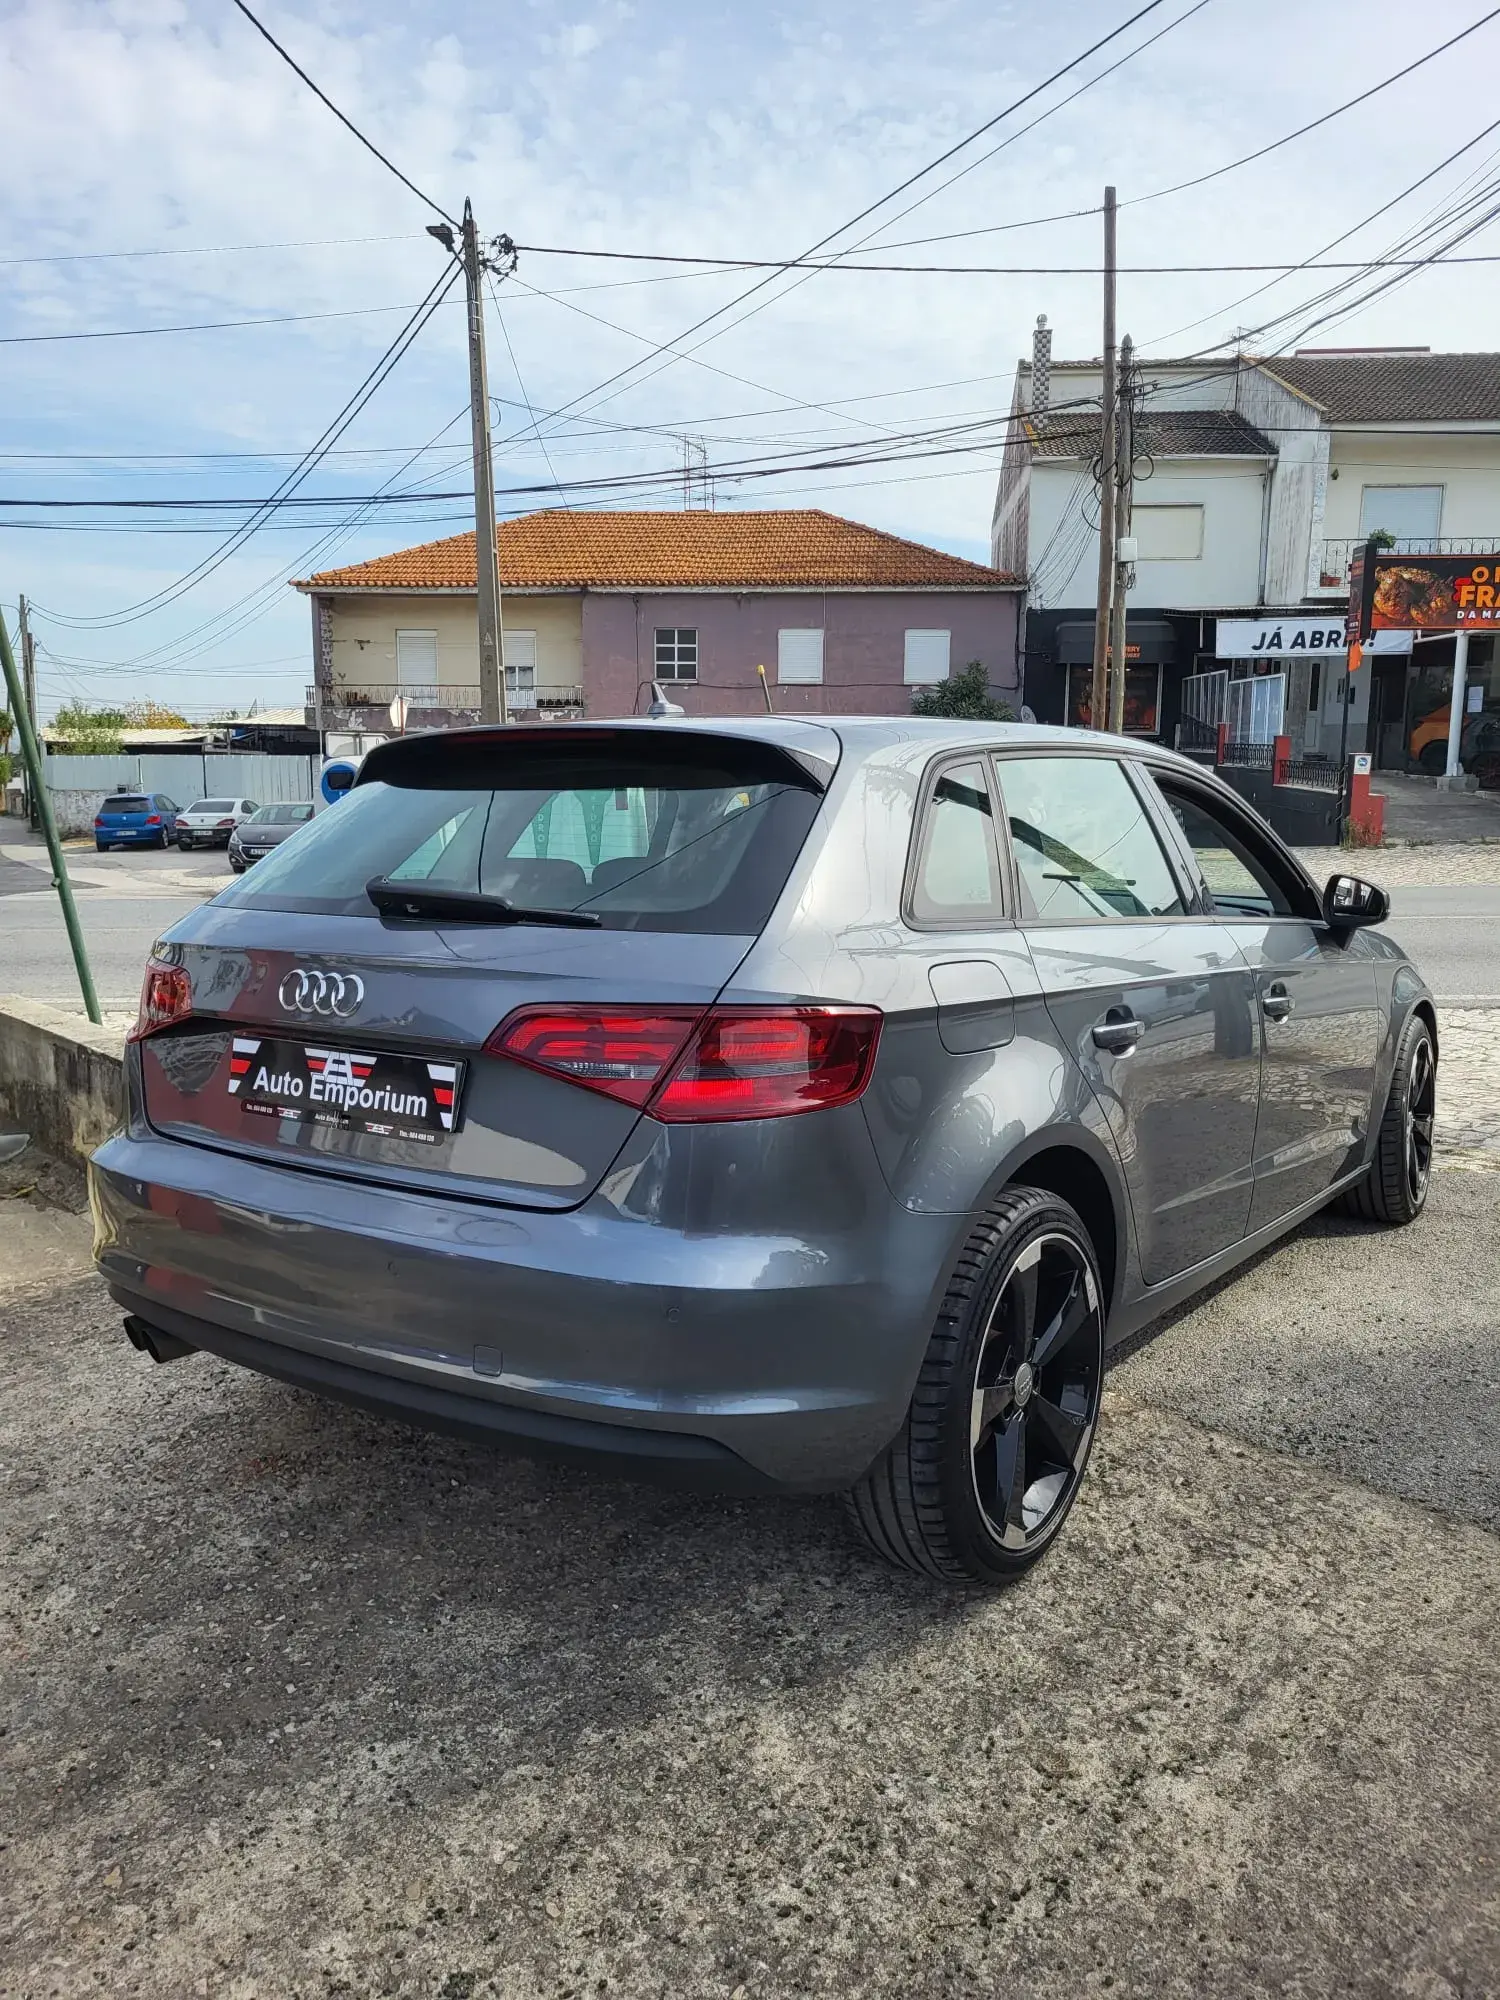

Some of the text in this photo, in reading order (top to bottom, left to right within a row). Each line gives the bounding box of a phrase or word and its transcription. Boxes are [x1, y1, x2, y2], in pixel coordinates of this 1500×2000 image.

[1251, 626, 1283, 650] JÁ
[252, 1066, 428, 1117] Auto Emporium
